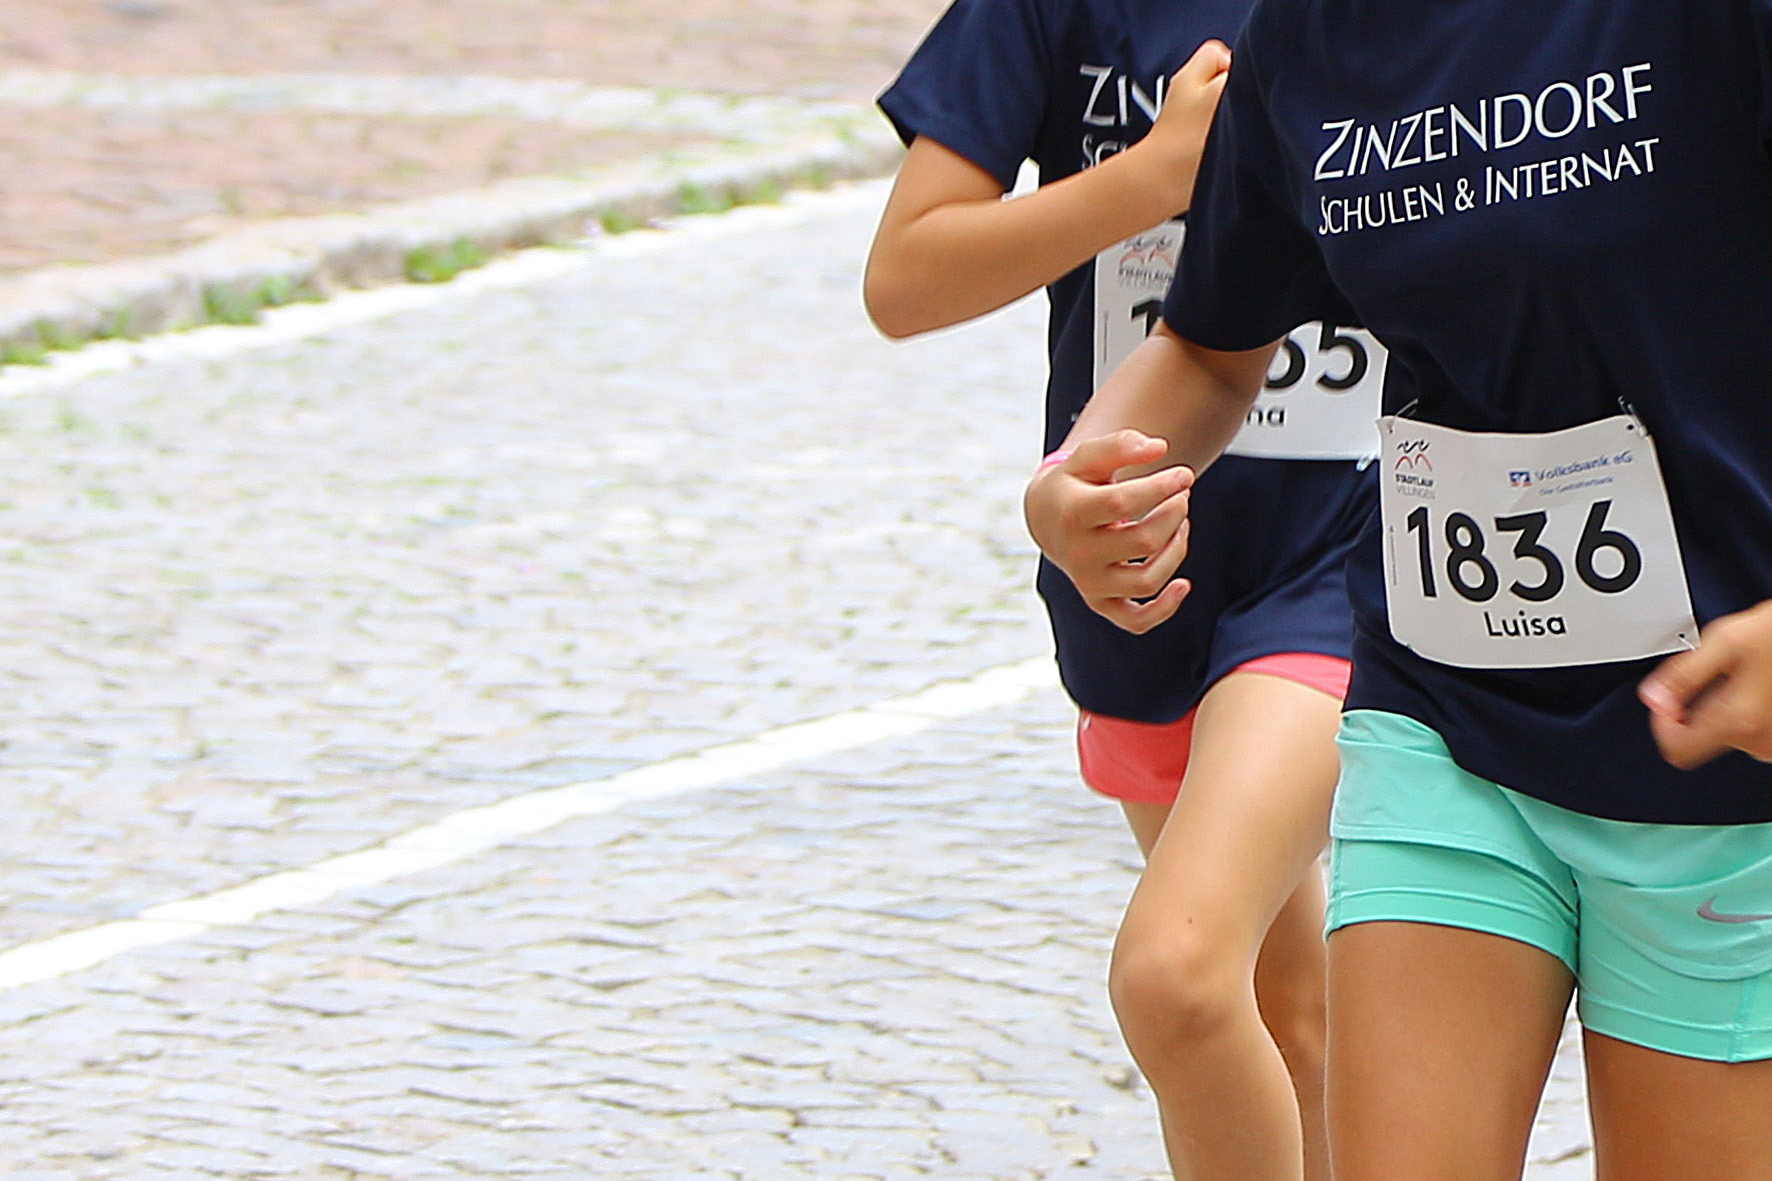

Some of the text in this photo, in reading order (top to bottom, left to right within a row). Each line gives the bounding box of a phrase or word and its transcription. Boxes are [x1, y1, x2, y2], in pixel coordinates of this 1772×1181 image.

[1314, 63, 1653, 181] ZINZENDORF
[1318, 138, 1660, 235] SCHULEN & INTERNAT
[1395, 472, 1435, 488] STADTLAUF
[1534, 457, 1611, 481] Volksbank
[1396, 485, 1436, 500] VILLINGEN
[1407, 499, 1642, 602] 1836
[1484, 610, 1567, 637] Luisa
